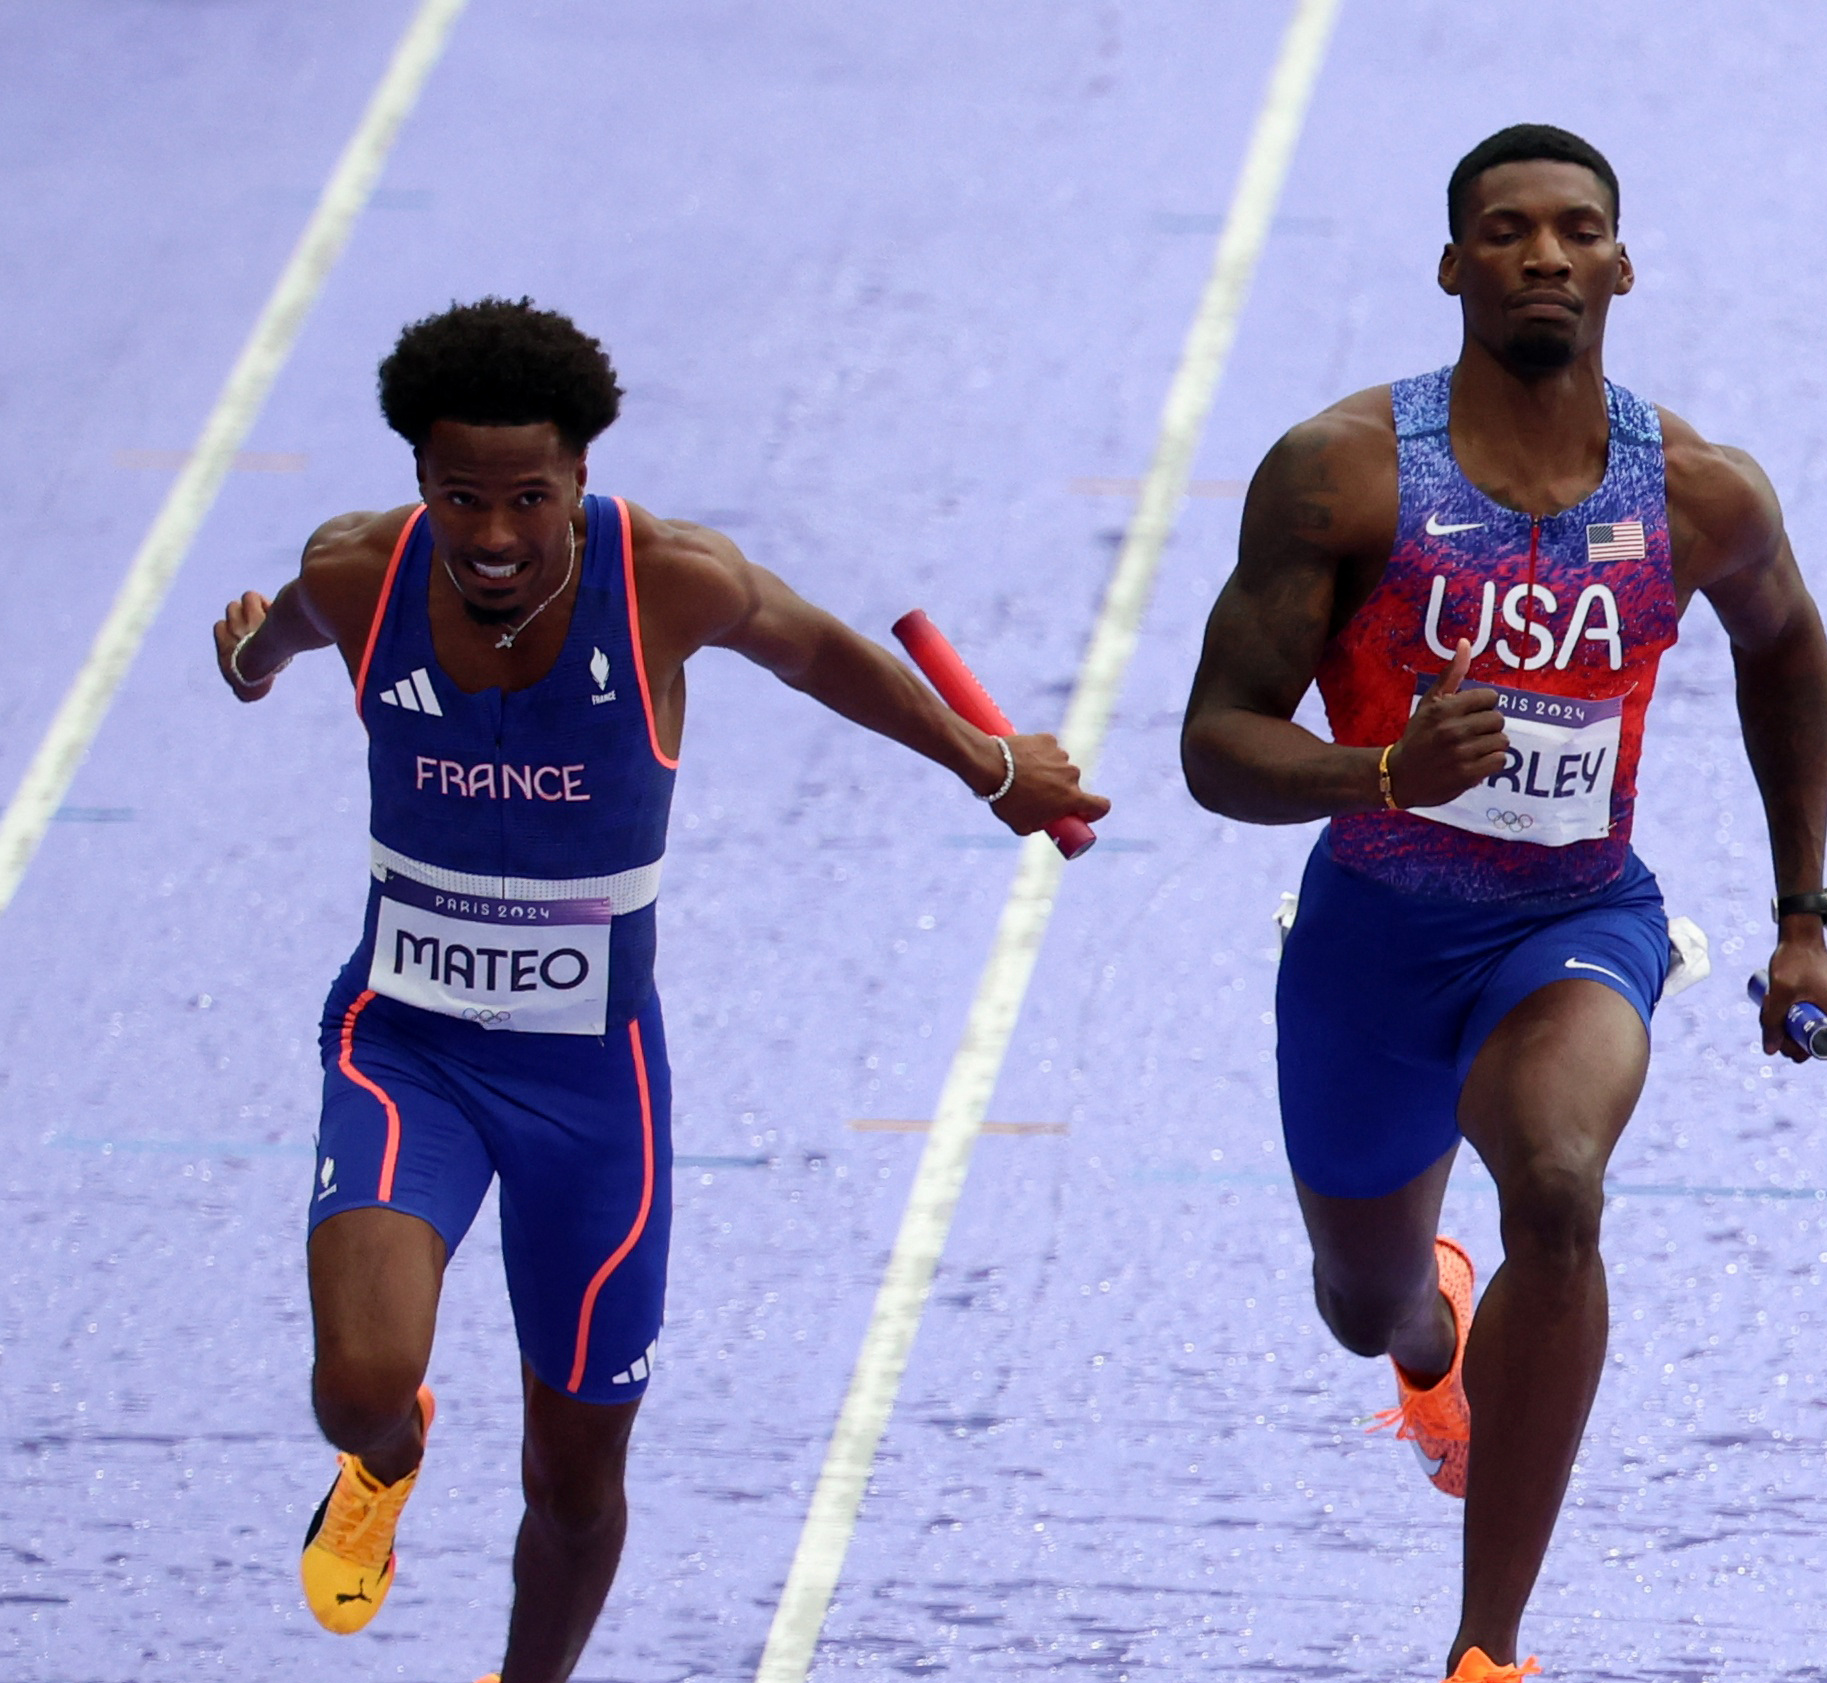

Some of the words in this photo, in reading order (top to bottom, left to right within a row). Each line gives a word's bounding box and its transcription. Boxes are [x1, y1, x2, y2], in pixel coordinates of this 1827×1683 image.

[1425, 574, 1622, 671] USA
[1498, 694, 1529, 712] RIS
[1535, 701, 1586, 721] 2024
[416, 756, 591, 801] FRANCE
[1487, 746, 1607, 799] RLEY
[435, 895, 490, 916] PARIS
[498, 905, 550, 919] 2024
[394, 929, 589, 992] MATEO
